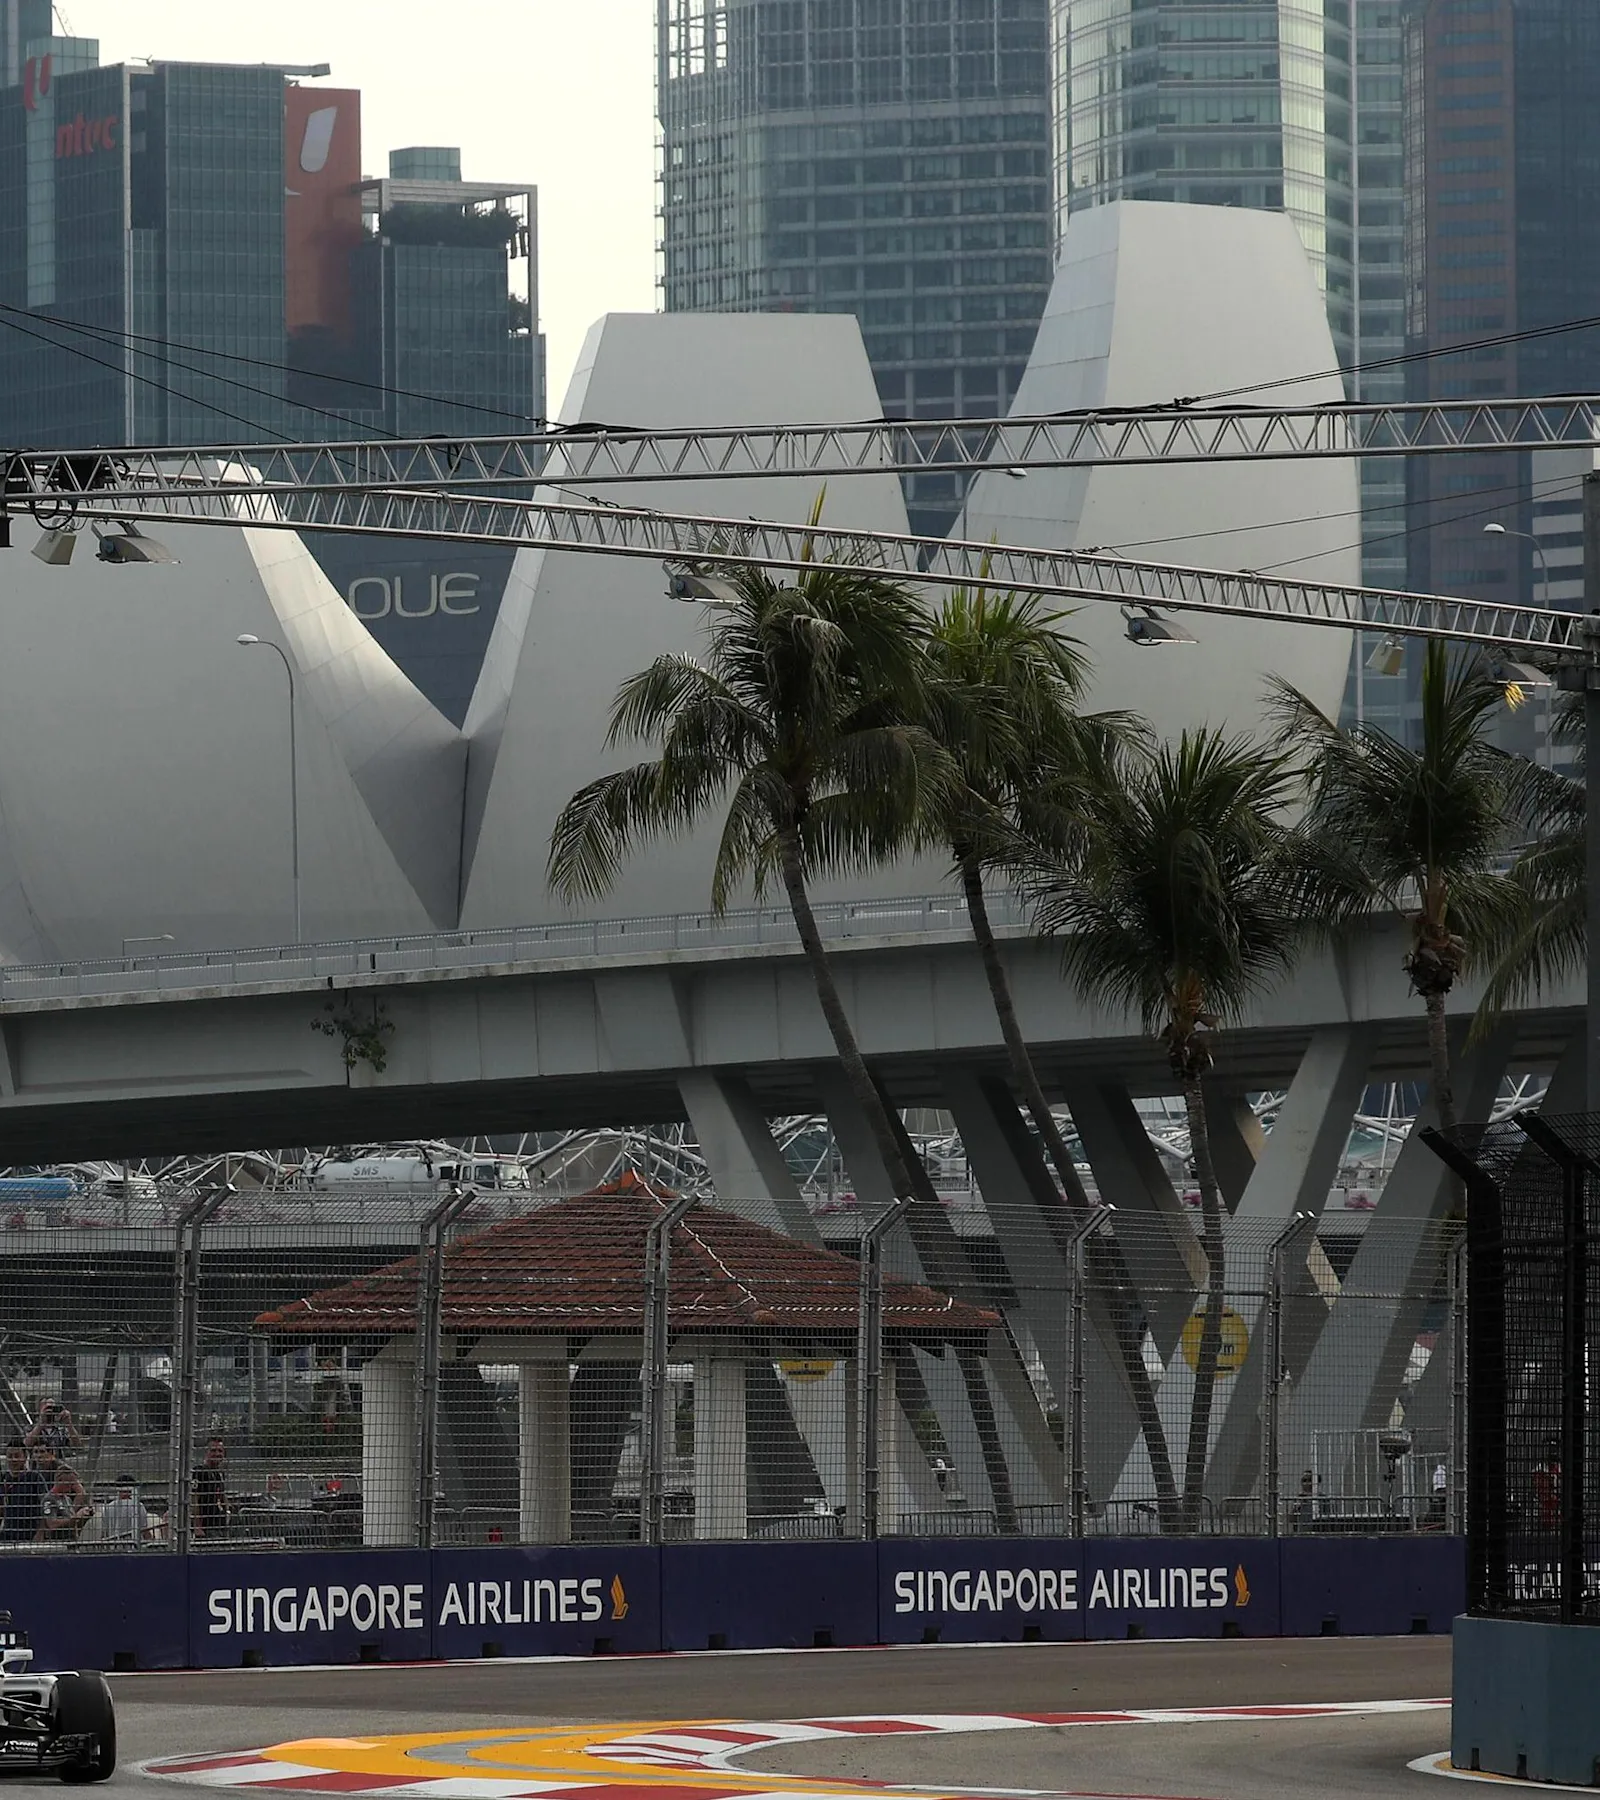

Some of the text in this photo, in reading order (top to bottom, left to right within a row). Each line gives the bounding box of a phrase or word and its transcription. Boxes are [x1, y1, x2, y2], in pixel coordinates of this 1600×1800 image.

[55, 112, 118, 160] ntuc
[348, 572, 480, 620] OUE
[353, 1166, 379, 1177] SMS
[208, 1578, 603, 1634] SINGAPORE AIRLINES
[894, 1567, 1228, 1613] SINGAPORE AIRLINES
